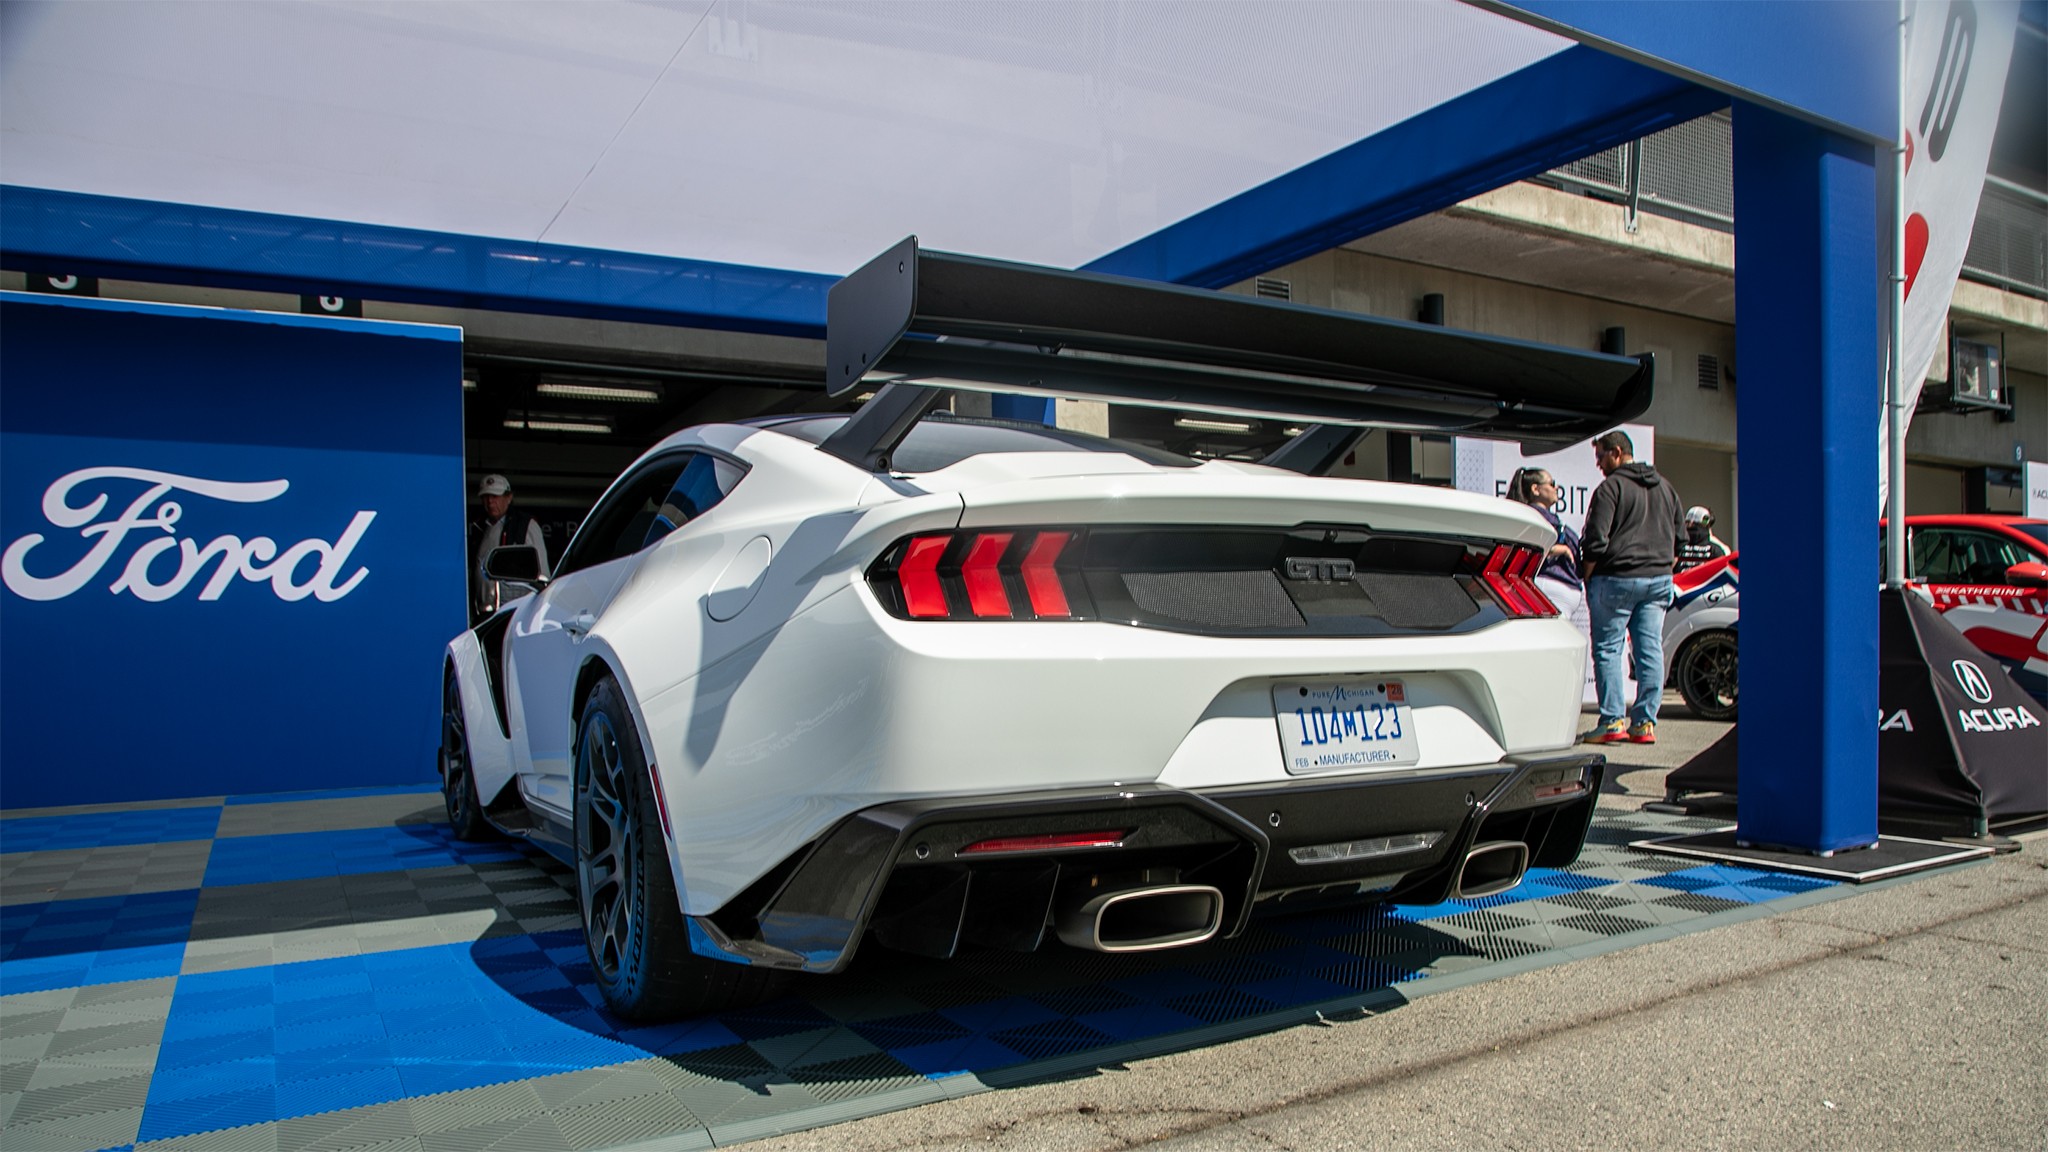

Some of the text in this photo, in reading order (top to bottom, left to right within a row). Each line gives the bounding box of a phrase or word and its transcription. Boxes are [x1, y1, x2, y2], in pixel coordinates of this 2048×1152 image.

[1495, 480, 1588, 514] EBIT
[2, 466, 377, 602] Ford
[1286, 557, 1355, 580] GTD
[1950, 587, 2025, 596] KATHERINE
[1312, 691, 1330, 699] PURE
[1296, 703, 1402, 746] 104M123
[1958, 706, 2041, 733] ACURA
[1295, 750, 1391, 768] FEB MANUFACTURER
[633, 859, 643, 959] MICHELIN
